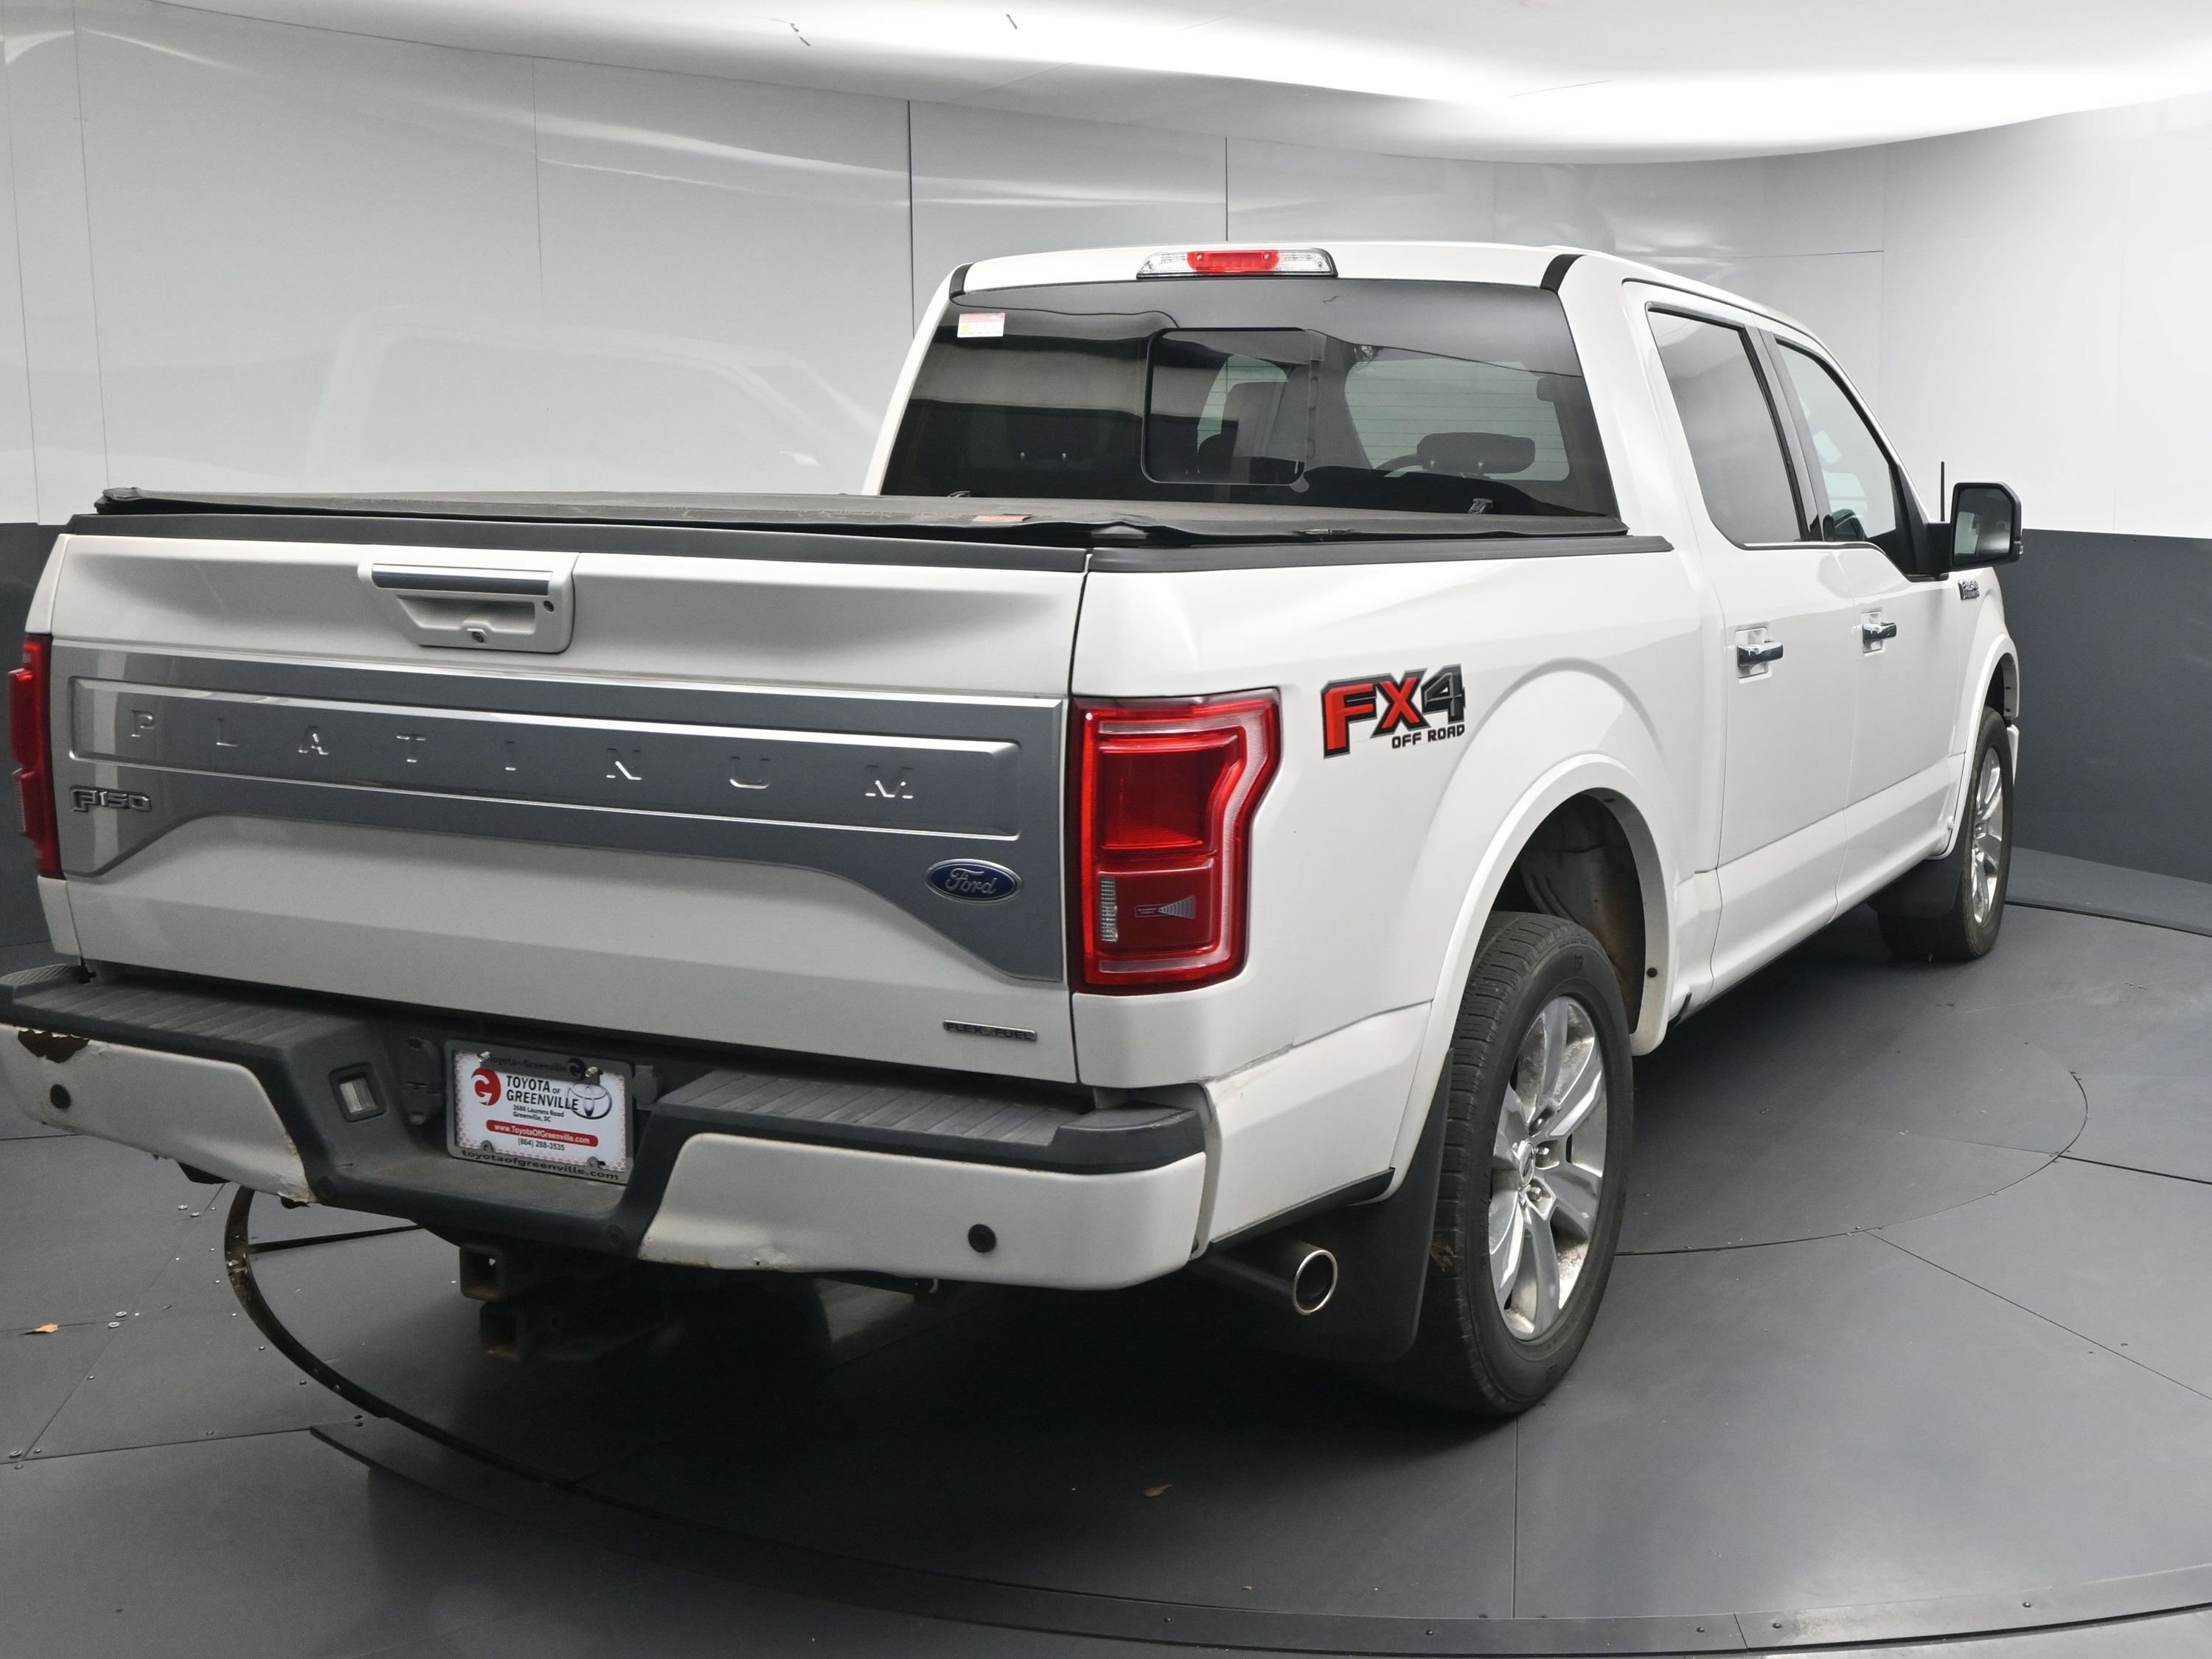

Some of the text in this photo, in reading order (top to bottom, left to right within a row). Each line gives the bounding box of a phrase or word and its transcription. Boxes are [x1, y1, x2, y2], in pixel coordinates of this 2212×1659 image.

[1321, 664, 1466, 759] FX4
[1391, 724, 1466, 749] OFF ROAD
[131, 709, 914, 799] PLATINUM
[945, 868, 998, 894] Ford
[945, 1022, 1036, 1040] FLEX FUEL
[506, 1075, 551, 1093] TOYOTA
[506, 1089, 579, 1110] GREENVILLE
[527, 1107, 549, 1115] Laurens
[550, 1110, 565, 1118] Road
[494, 1124, 591, 1144] www.ToyotaOfGreenville.com
[518, 1138, 566, 1151] (864) 288-3535
[462, 1148, 619, 1180] toyotaofgreenville.com
